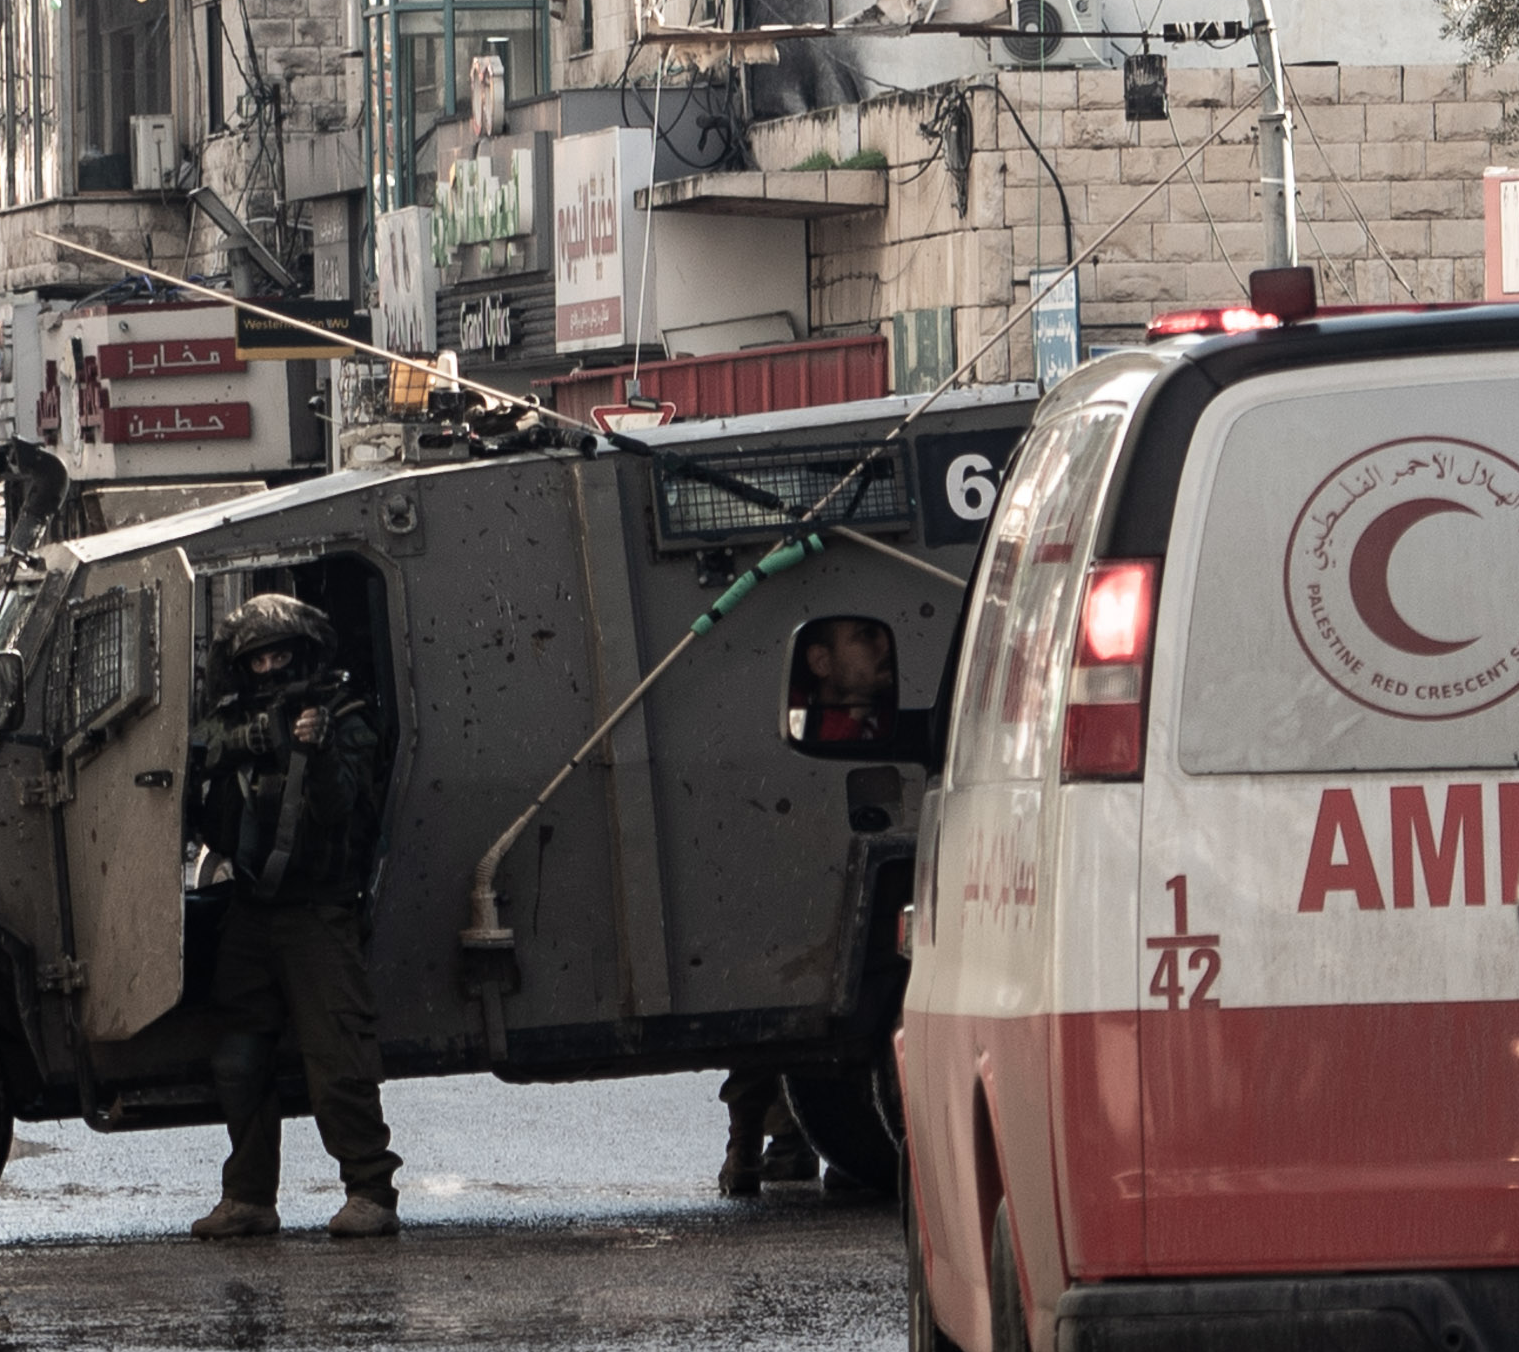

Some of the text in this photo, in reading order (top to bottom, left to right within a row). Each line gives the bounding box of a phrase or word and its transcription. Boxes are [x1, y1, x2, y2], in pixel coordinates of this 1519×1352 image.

[127, 344, 221, 374] مخابز
[460, 297, 483, 351] Grand
[485, 294, 511, 362] Optics
[129, 409, 225, 439] حطين
[1304, 464, 1384, 572] الفلسطيني
[1306, 583, 1365, 675] PALESTINE
[1370, 671, 1409, 697] RED
[1415, 658, 1510, 701] CRESCENT
[1148, 948, 1221, 1012] 42
